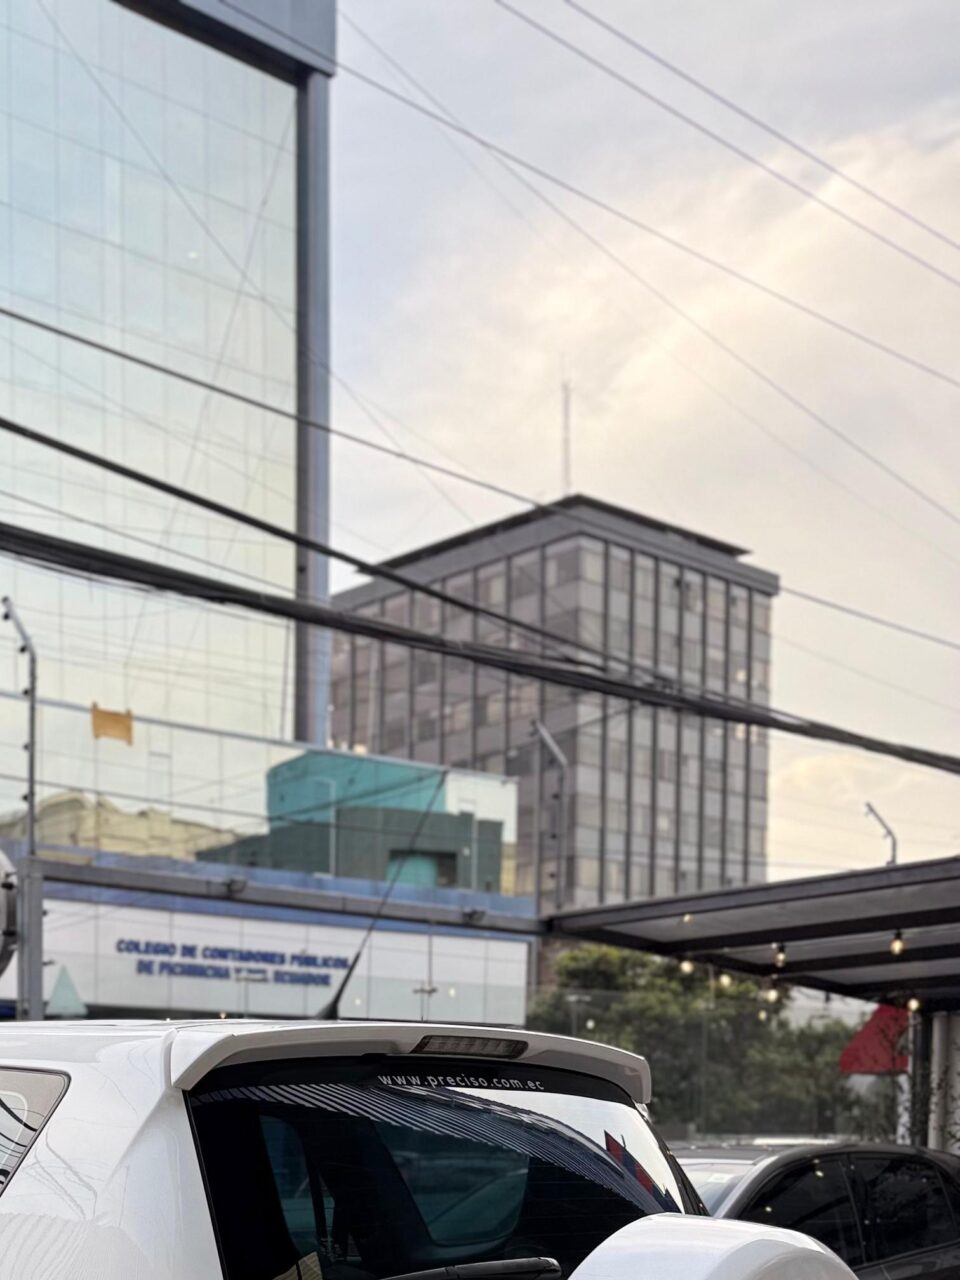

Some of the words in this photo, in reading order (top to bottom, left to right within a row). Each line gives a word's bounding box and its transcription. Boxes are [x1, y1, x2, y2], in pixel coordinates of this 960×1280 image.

[116, 939, 176, 956] COLEGIO
[181, 944, 197, 958] DE
[136, 959, 154, 976] DE
[378, 1074, 544, 1090] www.preciso.com.ec
